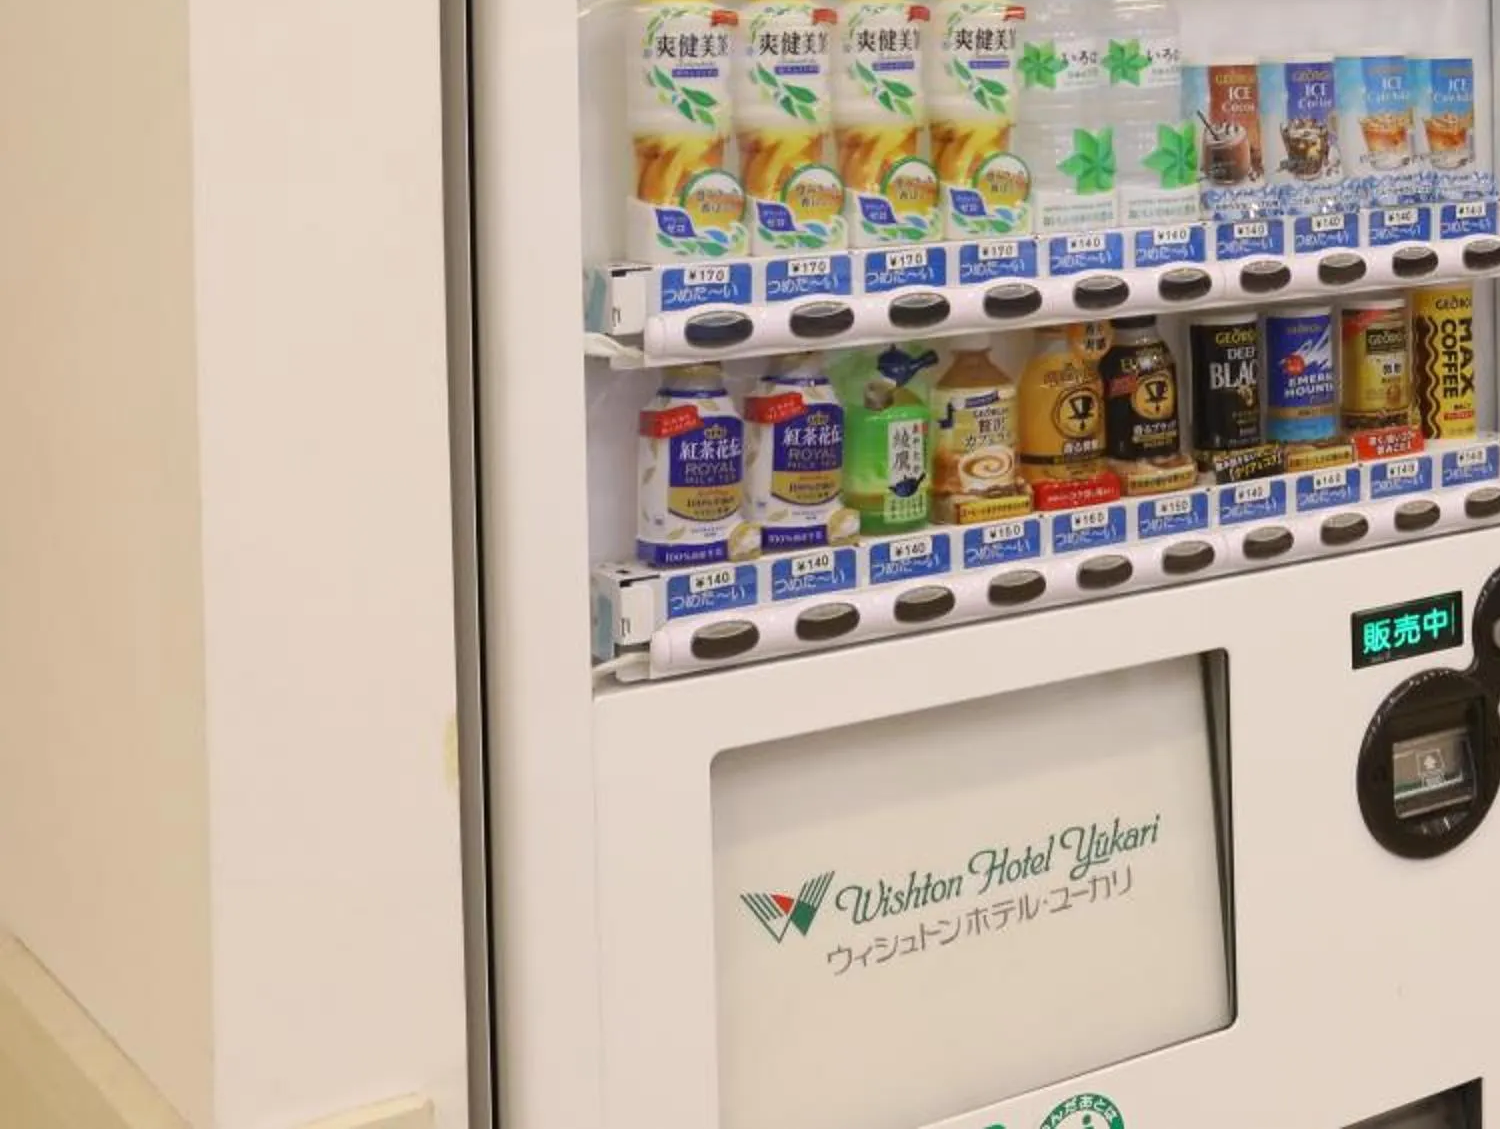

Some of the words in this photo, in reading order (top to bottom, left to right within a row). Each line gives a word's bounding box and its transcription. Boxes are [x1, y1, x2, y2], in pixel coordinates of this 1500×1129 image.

[1228, 87, 1253, 101] ICE
[1305, 83, 1328, 97] ICE
[1070, 237, 1101, 249] ¥140
[889, 251, 923, 265] ¥170
[982, 245, 1013, 257] ¥170
[792, 260, 827, 273] ¥170
[688, 269, 725, 282] ¥170
[1441, 318, 1459, 399] COFFEE
[1209, 362, 1257, 390] BLAC
[892, 542, 926, 556] ¥140
[796, 555, 829, 571] ¥140
[695, 572, 730, 589] ¥140
[1363, 608, 1448, 654] 販売中
[835, 871, 964, 925] Wishton
[967, 835, 1055, 896] Hotel
